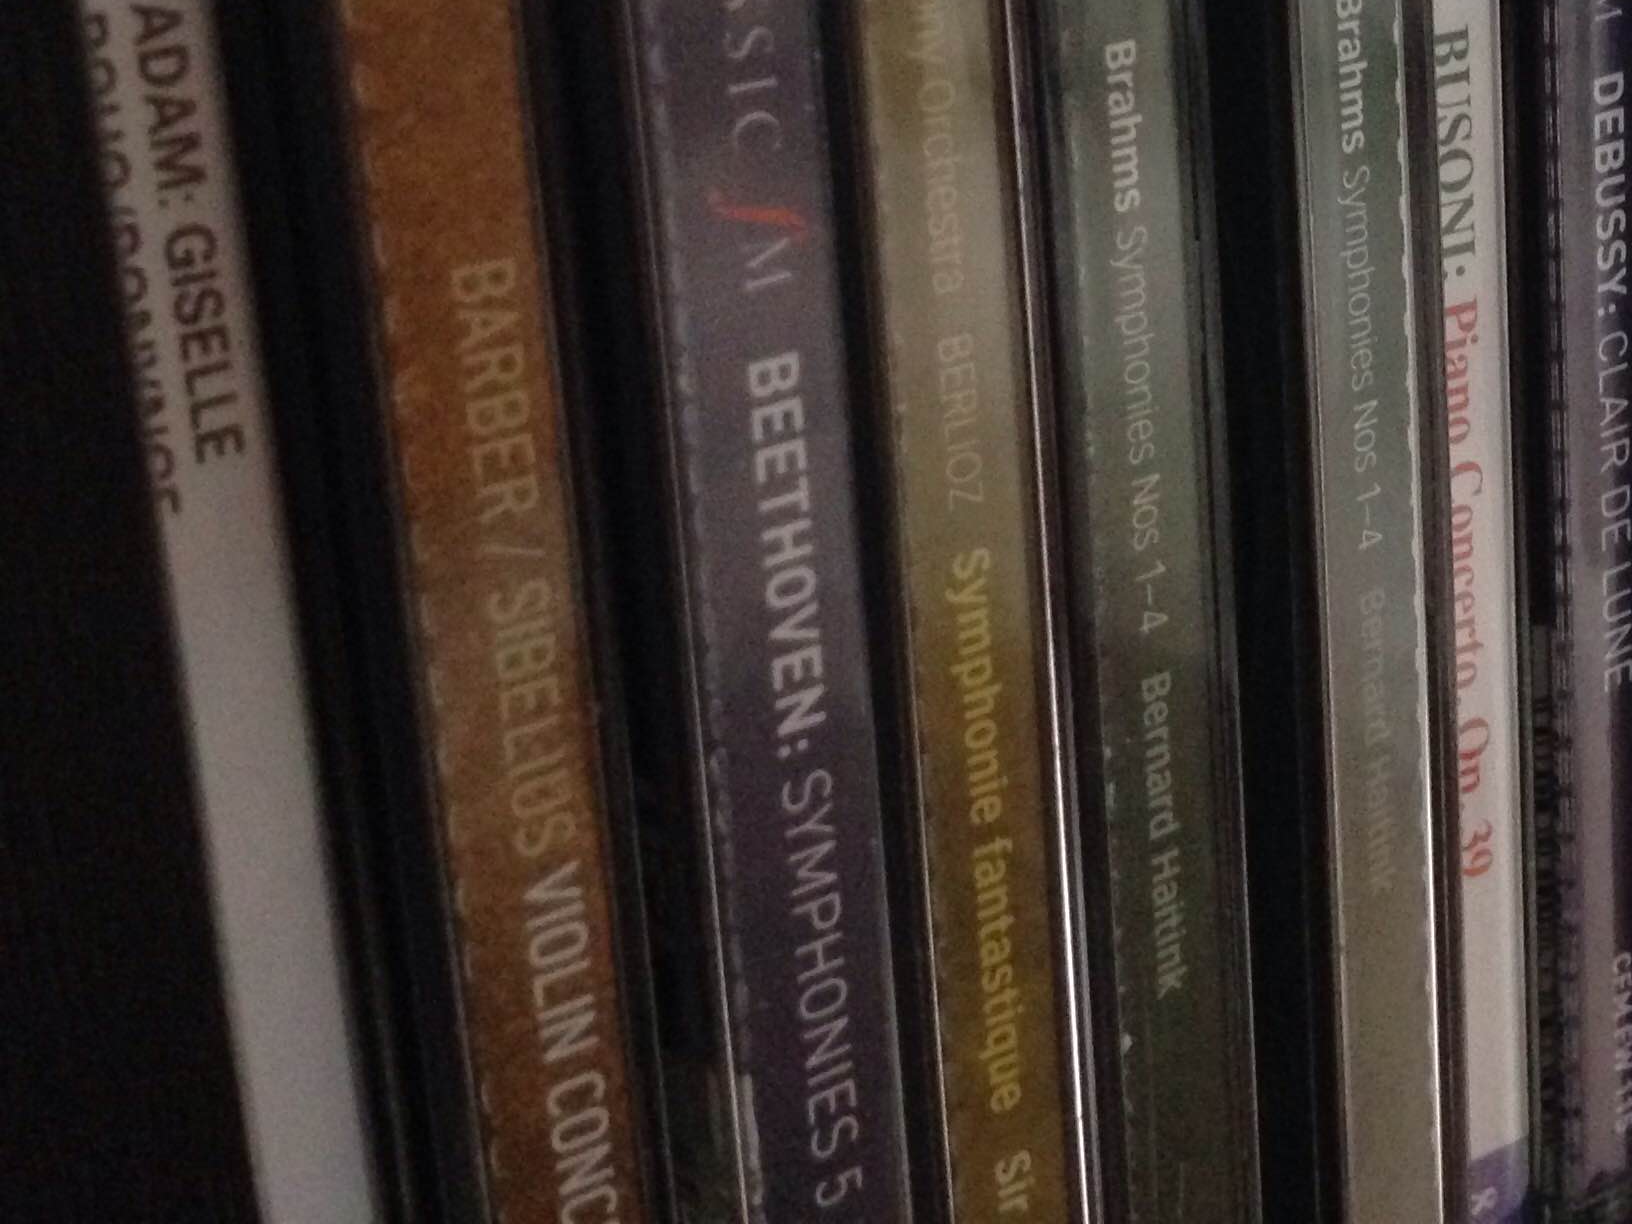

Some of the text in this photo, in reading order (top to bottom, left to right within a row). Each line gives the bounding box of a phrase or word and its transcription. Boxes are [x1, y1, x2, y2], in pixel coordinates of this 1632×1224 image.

[916, 79, 968, 294] Orchestra
[1105, 38, 1142, 213] Brahms
[1432, 23, 1478, 281] BUSONI:
[1593, 72, 1628, 316] DEBUSSY:
[129, 3, 246, 464] ADAM: GISELLE
[1337, 164, 1377, 393] Symphonies
[451, 258, 540, 523] BARBER
[938, 332, 984, 510] BERLIOZ
[1111, 223, 1157, 466] Symphonies
[1353, 399, 1378, 474] Nos
[1443, 295, 1482, 448] Piano
[1599, 327, 1631, 473] CLAIR
[1131, 473, 1160, 552] Nos
[1600, 485, 1632, 549] DE
[488, 575, 577, 860] SIBELIUS
[945, 548, 1007, 825] Symphonie
[1140, 670, 1181, 841] Bernard
[1361, 588, 1390, 744] Bernard
[748, 352, 864, 1210] BEETHOVEN: SYMPHONIES 5
[1461, 819, 1493, 878] 39
[523, 861, 599, 1064] VIOLIN
[973, 836, 1024, 1112] fantastique
[1149, 853, 1188, 1001] Haitink
[997, 1149, 1031, 1213] Sir
